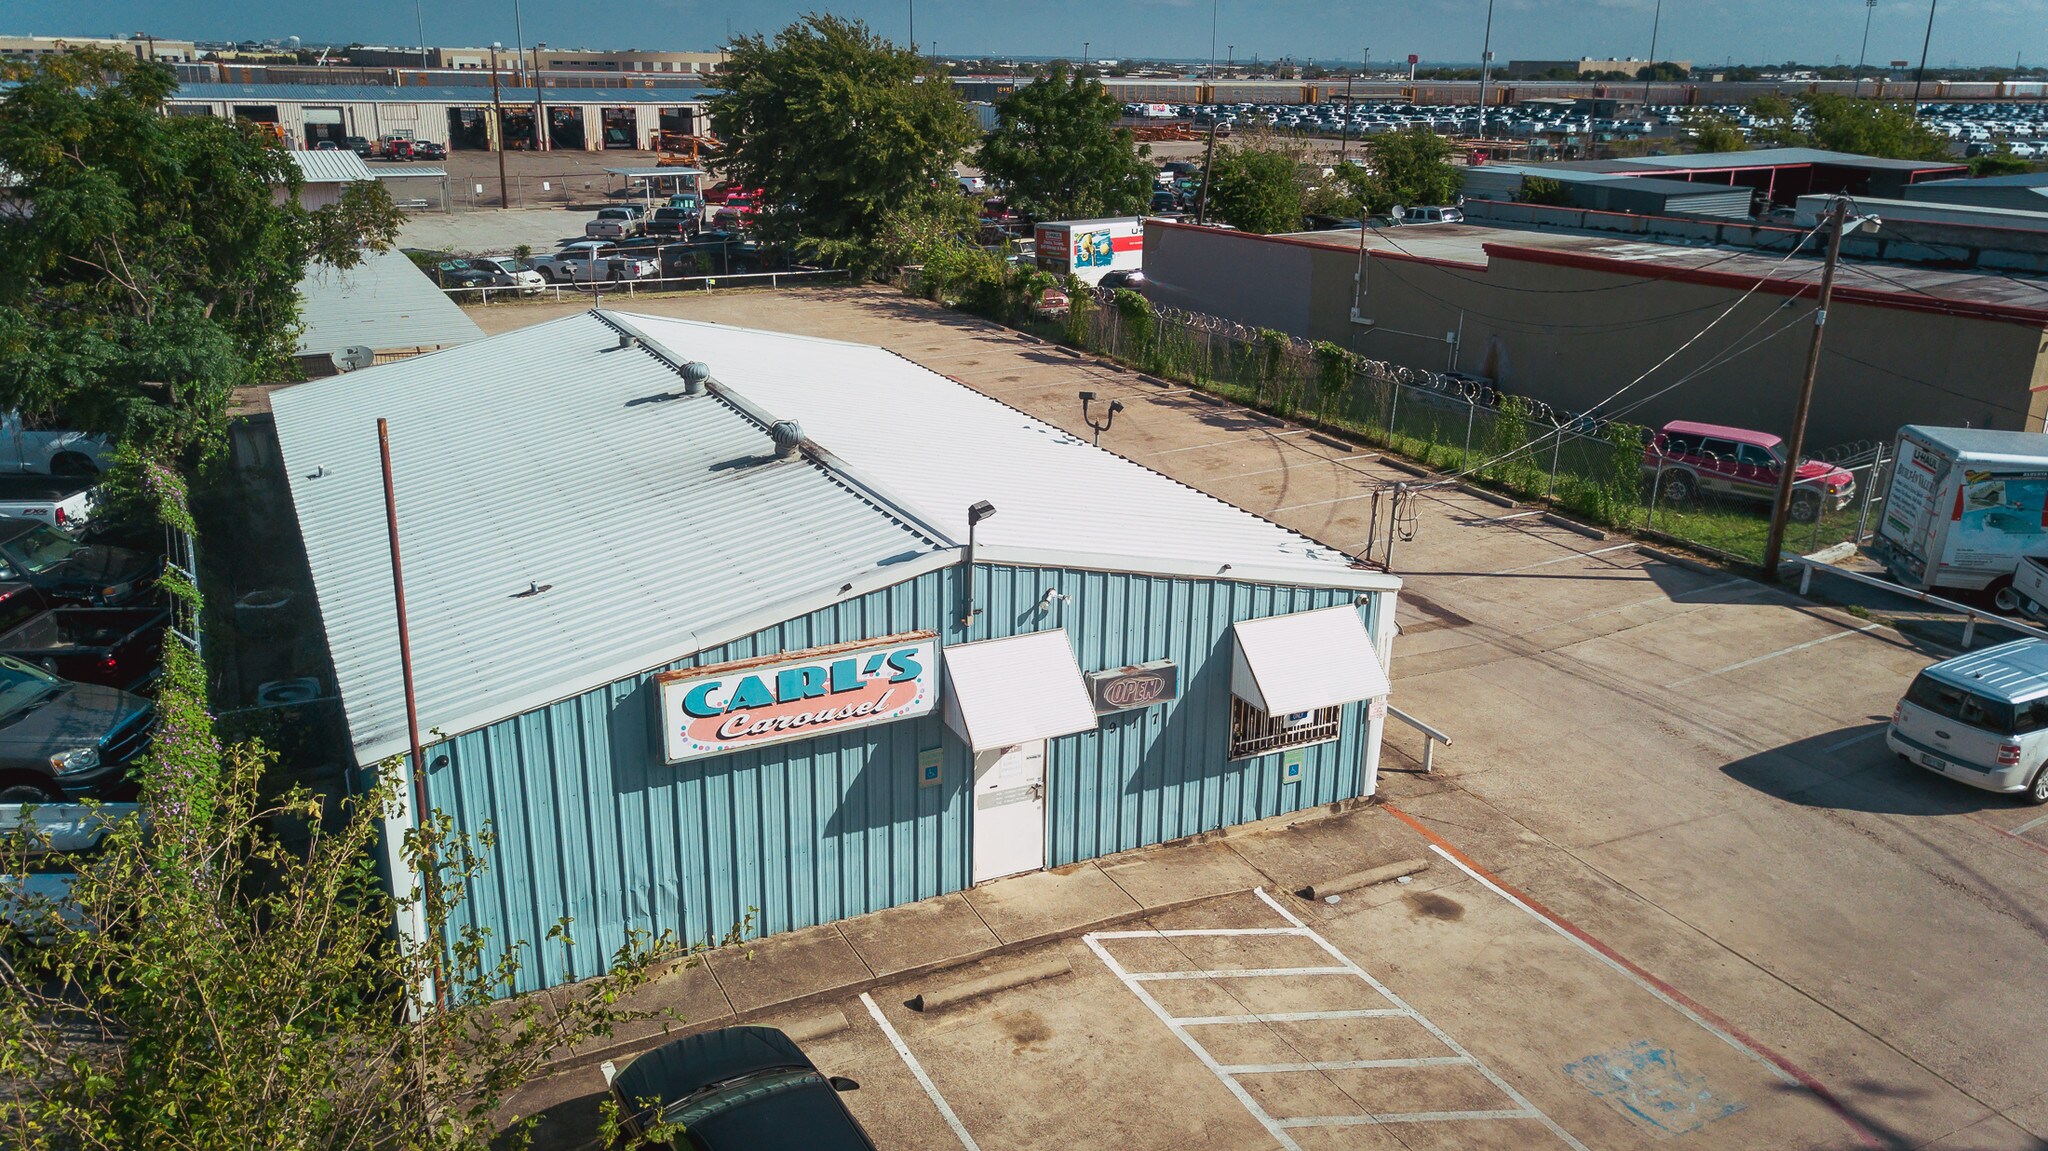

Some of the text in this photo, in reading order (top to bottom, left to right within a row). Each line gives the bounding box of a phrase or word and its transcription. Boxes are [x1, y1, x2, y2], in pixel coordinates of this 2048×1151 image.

[682, 648, 923, 719] CARL'S
[1111, 678, 1158, 703] OPEN
[716, 688, 896, 740] Carousel
